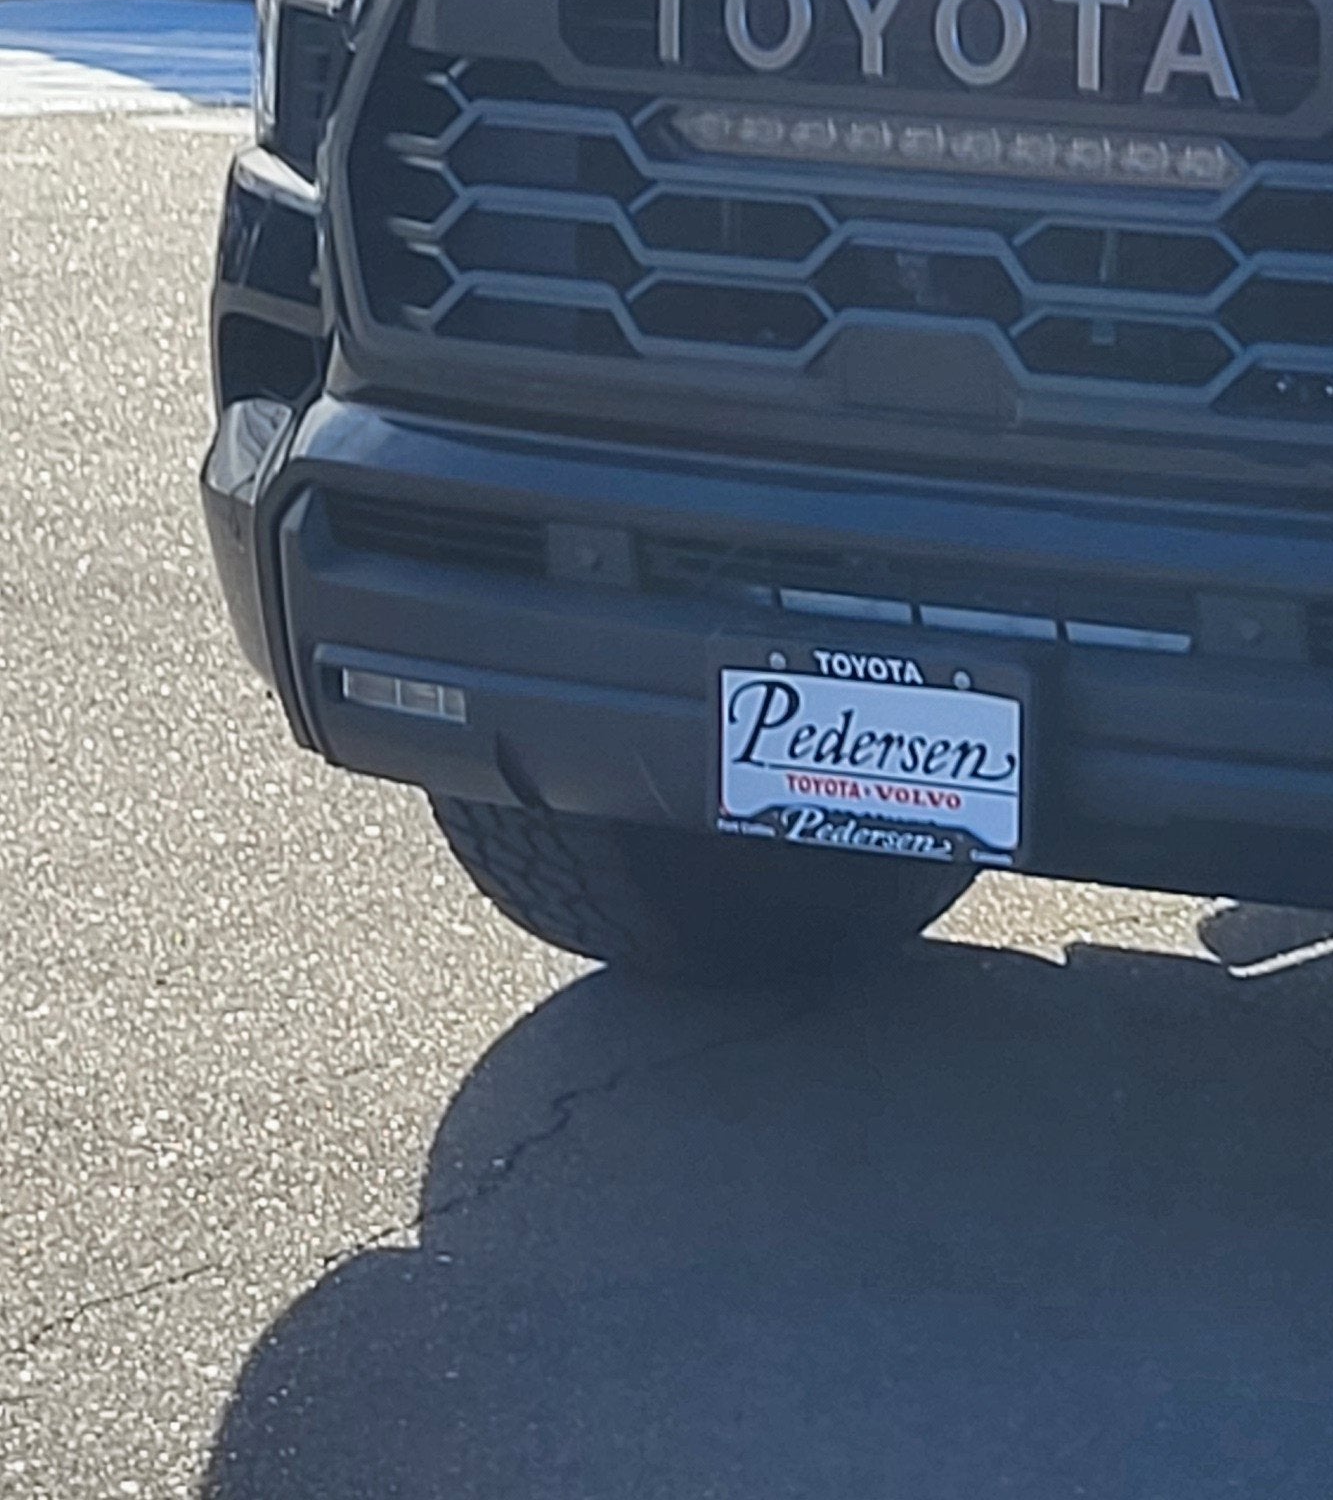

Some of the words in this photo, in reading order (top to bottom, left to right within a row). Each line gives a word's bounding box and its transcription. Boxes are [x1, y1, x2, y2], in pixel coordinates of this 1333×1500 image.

[813, 650, 924, 685] TOYOTA
[728, 680, 1016, 782] Pedersen
[786, 774, 861, 801] TOYOTA
[875, 785, 962, 811] VOLVO
[780, 805, 952, 855] Pedersen
